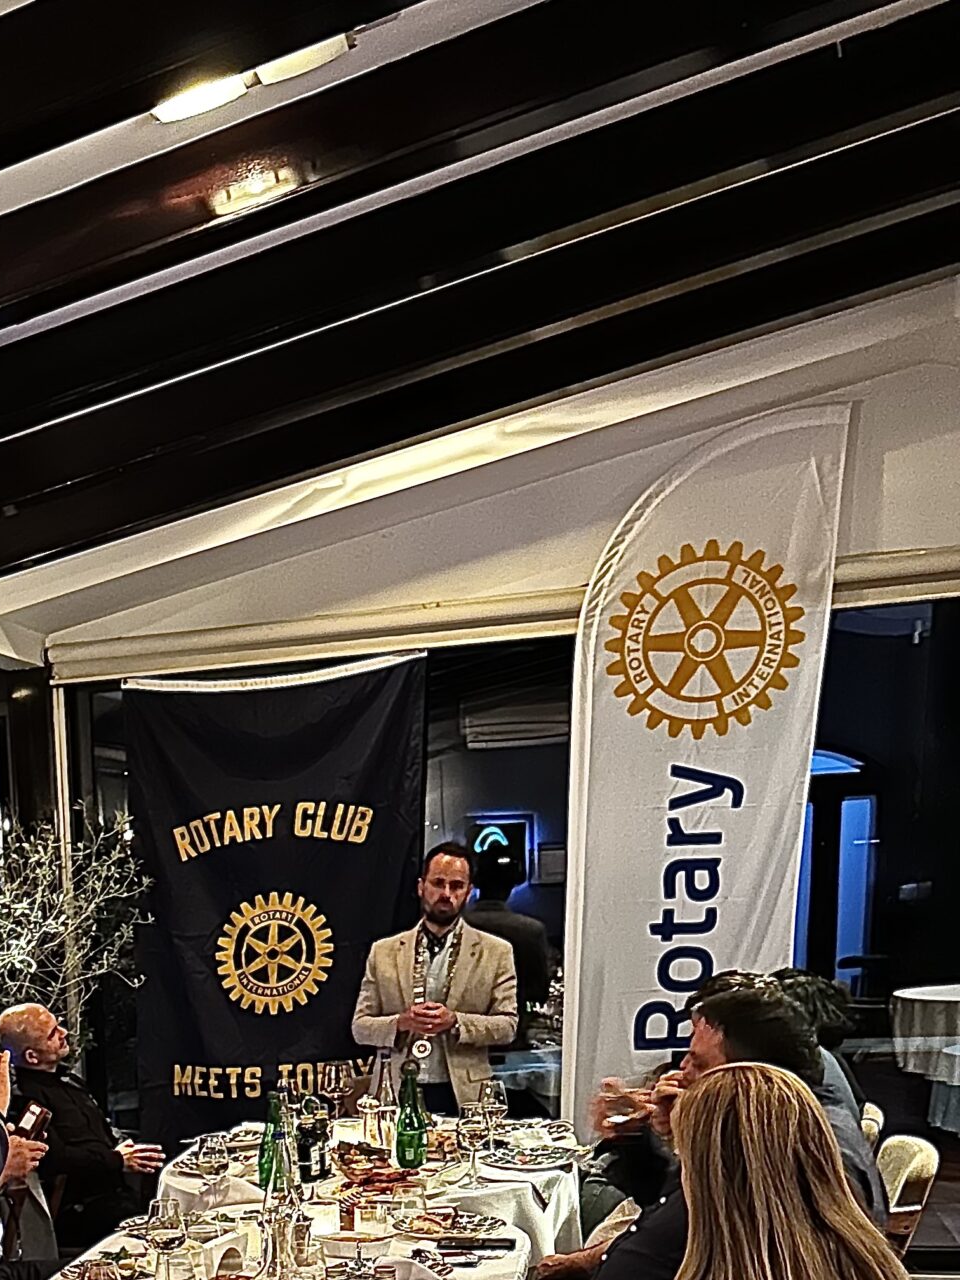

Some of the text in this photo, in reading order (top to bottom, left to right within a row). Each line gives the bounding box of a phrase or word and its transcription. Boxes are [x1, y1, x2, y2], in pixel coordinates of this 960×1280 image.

[628, 603, 651, 684] ROTARY
[732, 569, 784, 707] INTERNATIONAL
[173, 802, 374, 862] ROTARY CLUB
[253, 912, 294, 924] ROTARY
[633, 765, 743, 1050] Rotary
[239, 967, 311, 997] INTERNATIONAL
[174, 1065, 262, 1098] MEETS
